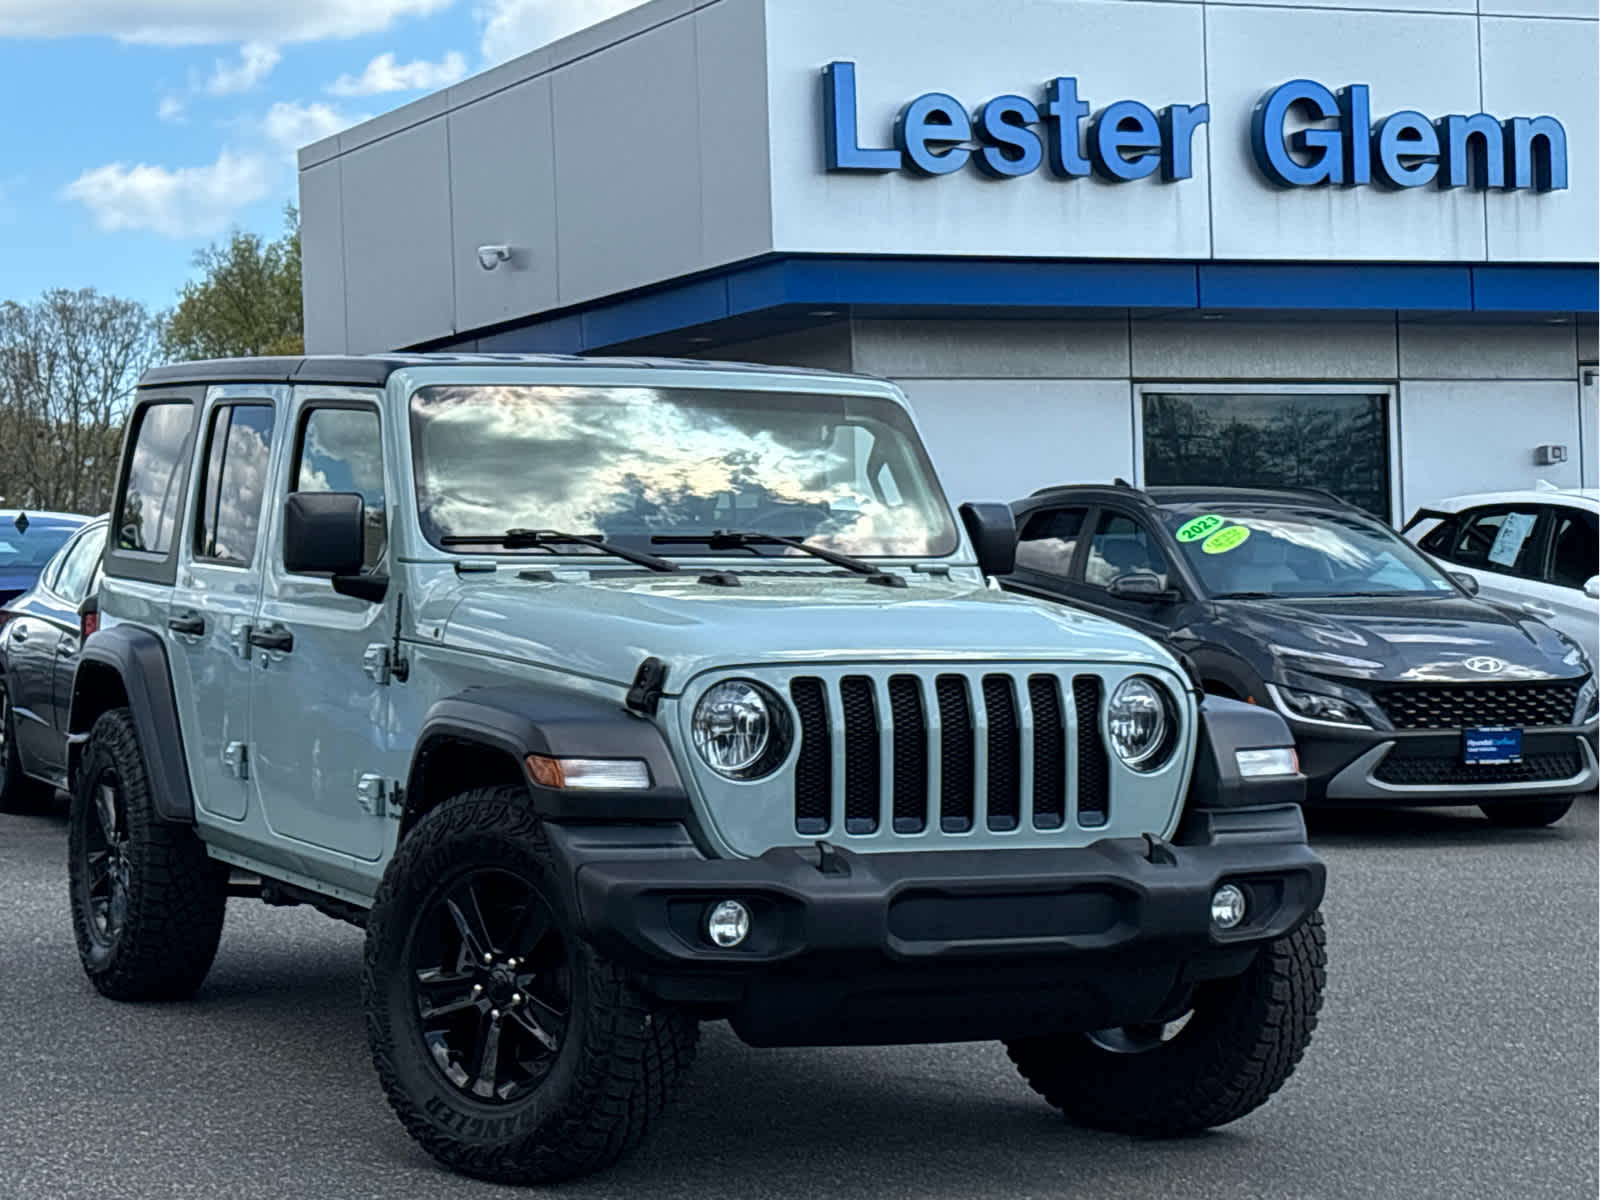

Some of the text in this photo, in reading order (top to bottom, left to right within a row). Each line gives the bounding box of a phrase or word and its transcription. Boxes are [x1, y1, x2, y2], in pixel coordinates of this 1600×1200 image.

[821, 60, 1569, 192] Lester Glenn
[1181, 516, 1220, 540] 2023
